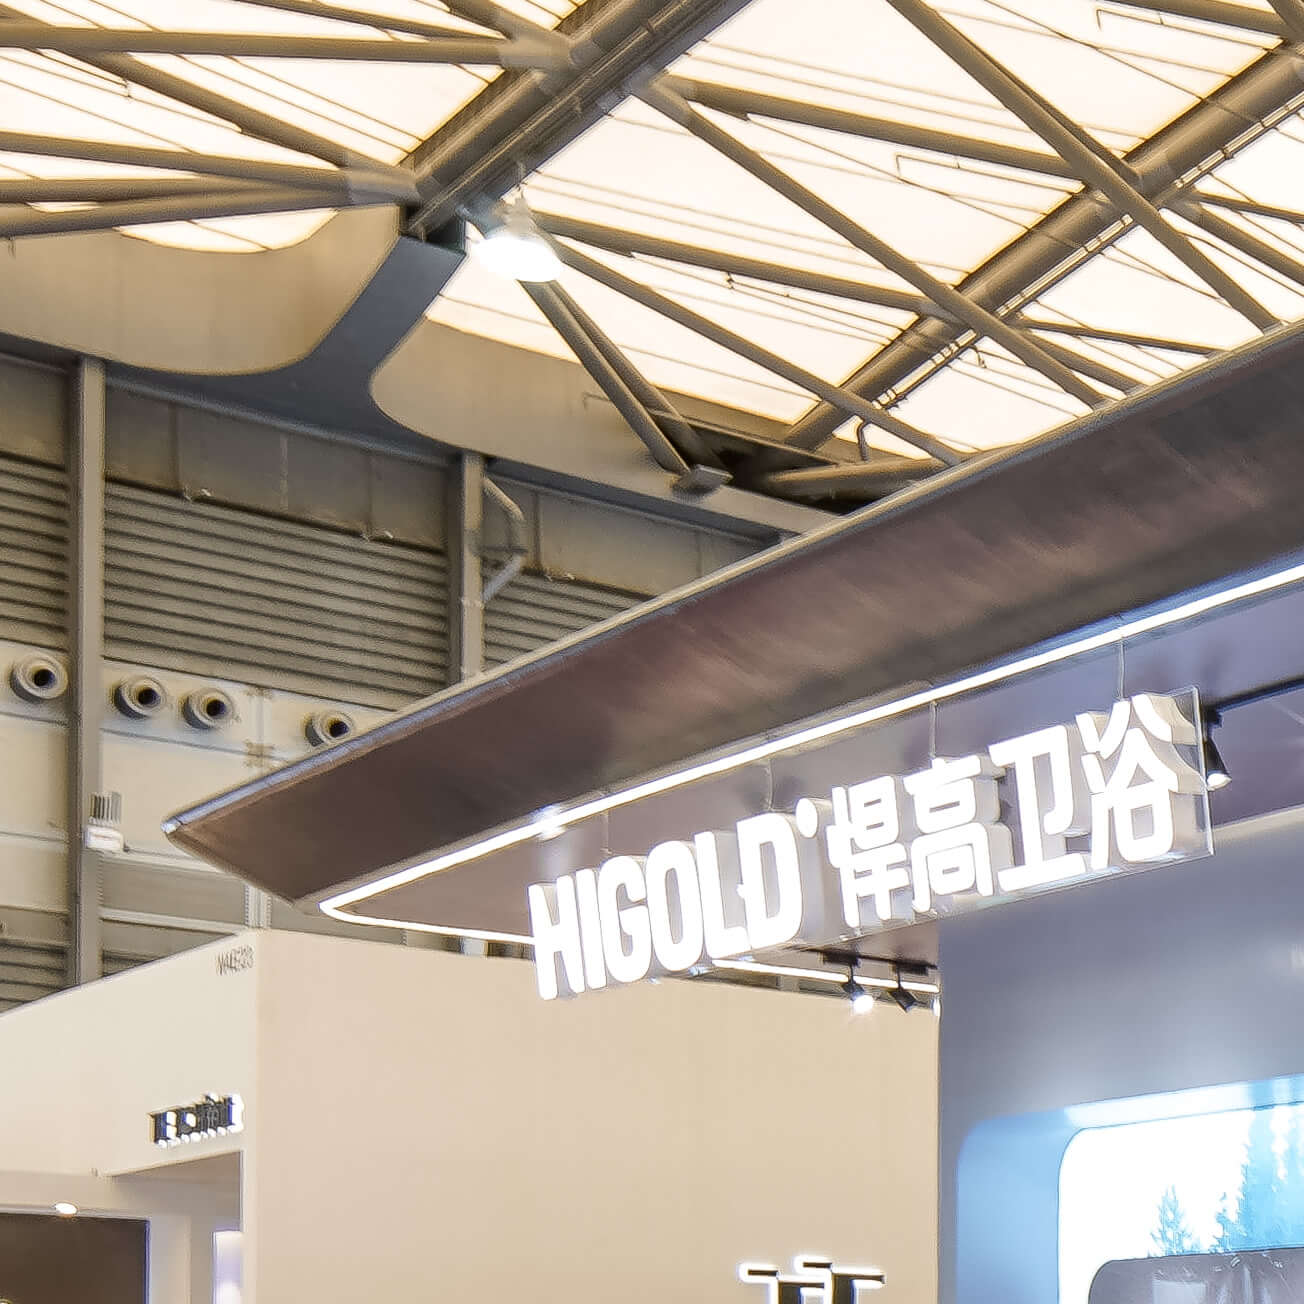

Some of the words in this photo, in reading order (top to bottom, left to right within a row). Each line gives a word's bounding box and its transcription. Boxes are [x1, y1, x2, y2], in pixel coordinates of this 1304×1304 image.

[528, 811, 804, 1001] HIGOLD
[825, 692, 1178, 929] 悍高卫浴
